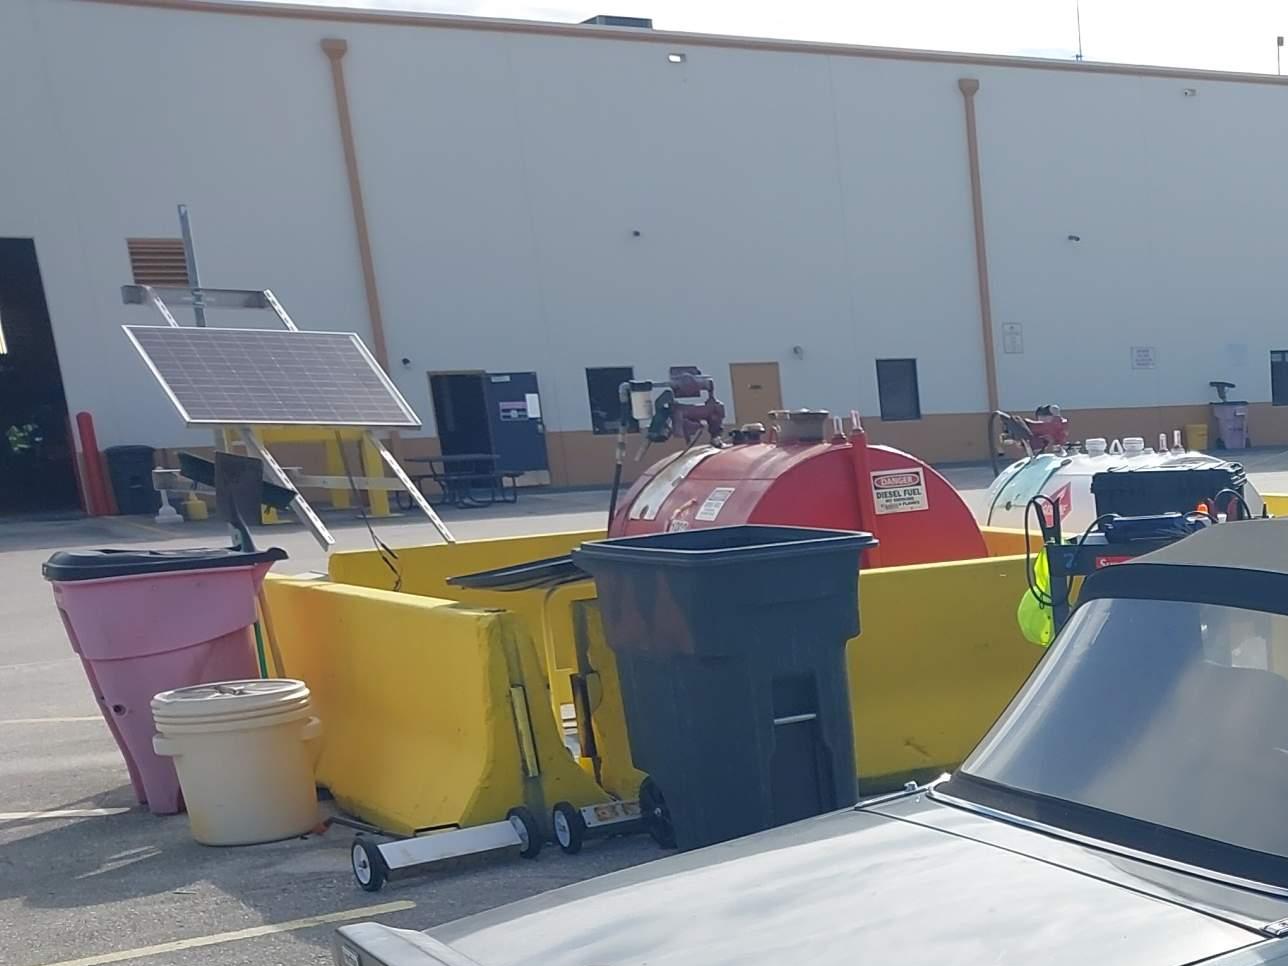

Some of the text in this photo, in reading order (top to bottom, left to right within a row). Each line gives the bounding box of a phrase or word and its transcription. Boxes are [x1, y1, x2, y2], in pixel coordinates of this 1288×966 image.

[880, 475, 913, 486] DANGER
[876, 488, 922, 499] DIESEL FUEL
